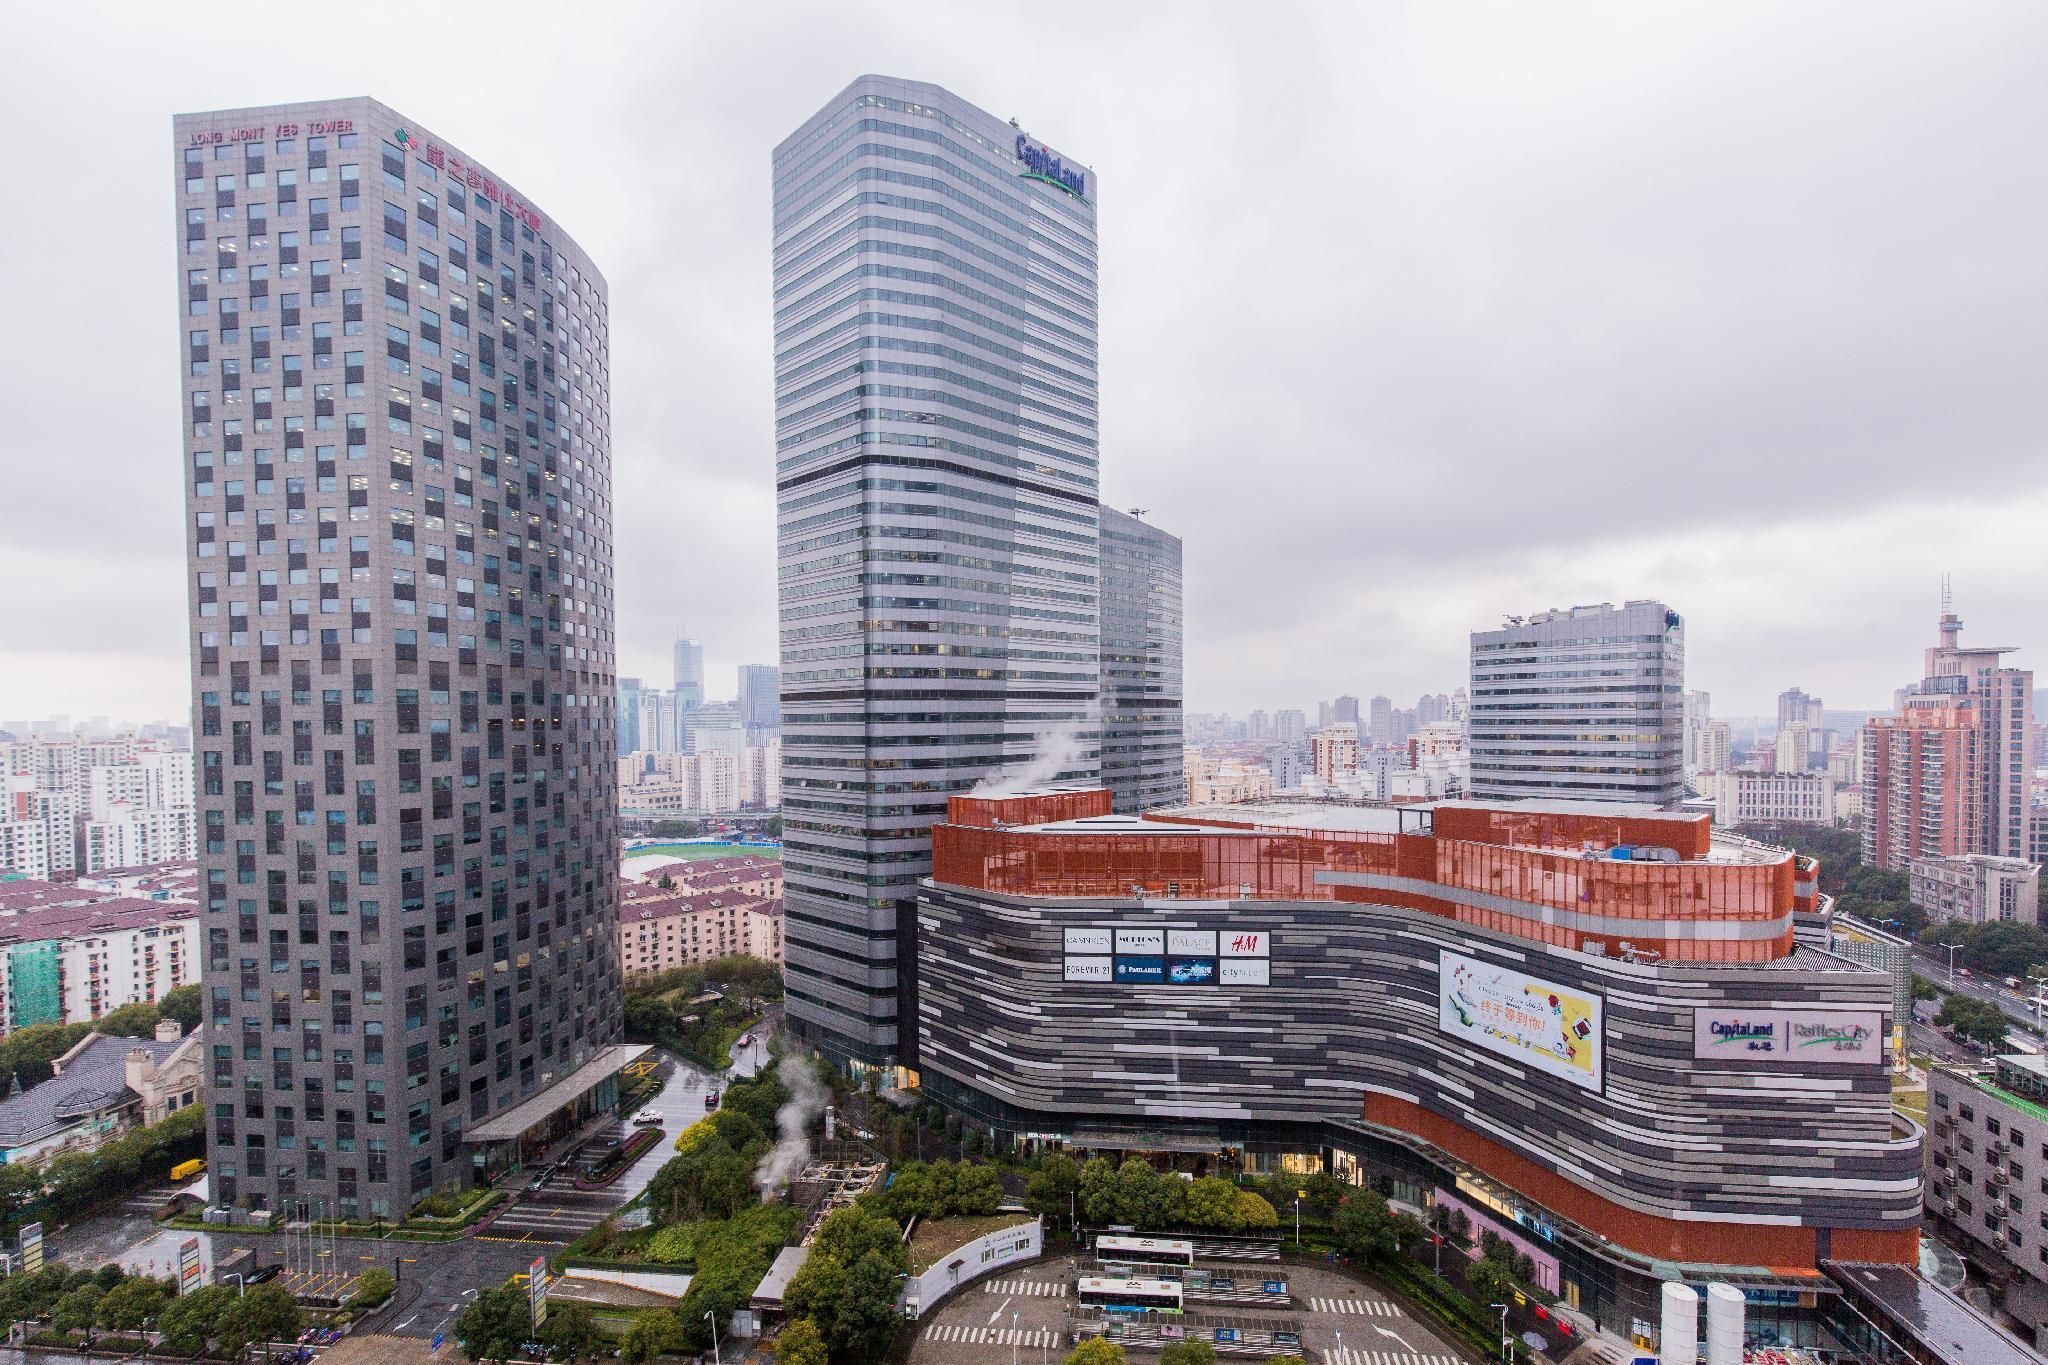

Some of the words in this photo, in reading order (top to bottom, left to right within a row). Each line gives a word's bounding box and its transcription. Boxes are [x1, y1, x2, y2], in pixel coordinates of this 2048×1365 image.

[191, 132, 223, 146] LONG
[230, 127, 265, 142] MONT
[275, 124, 299, 138] YES
[306, 120, 353, 134] TOWER
[1016, 134, 1085, 196] CapitaLand
[1231, 935, 1258, 952] H&M
[1066, 965, 1099, 974] FOREVER
[1102, 966, 1110, 975] 21
[1711, 1019, 1773, 1039] CapitaLand
